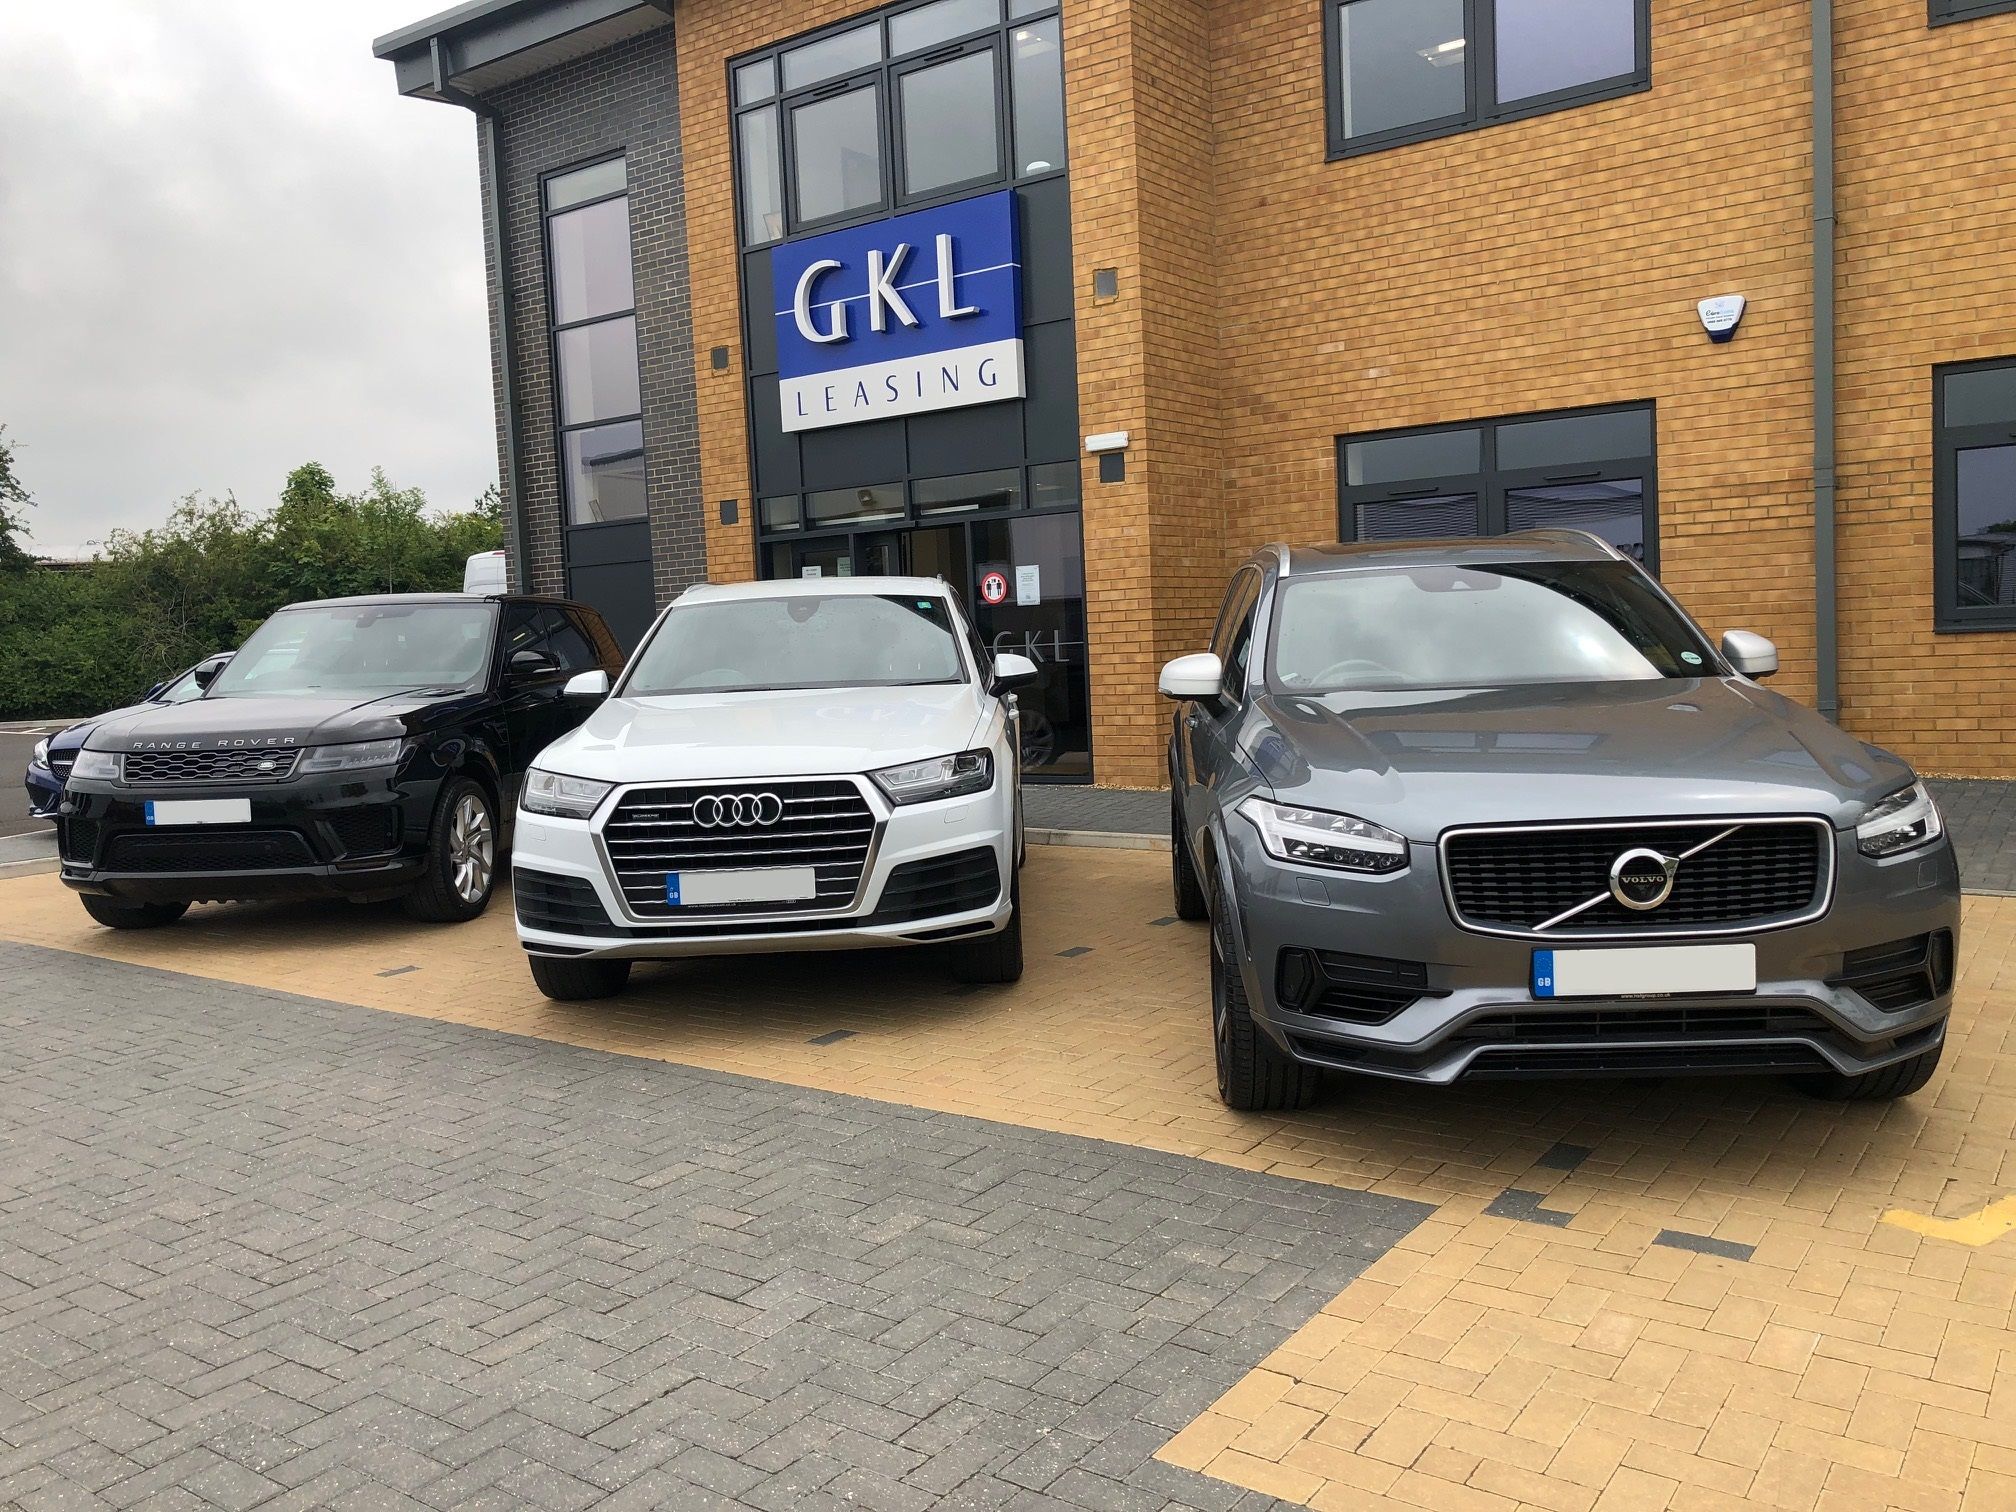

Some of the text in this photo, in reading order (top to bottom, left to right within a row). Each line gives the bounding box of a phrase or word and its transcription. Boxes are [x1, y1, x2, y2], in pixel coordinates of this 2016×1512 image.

[794, 233, 980, 343] GKL
[797, 358, 997, 416] LEASING
[993, 629, 1070, 663] GKL
[133, 737, 295, 749] RANGE ROVER
[669, 891, 679, 899] GB
[1537, 977, 1551, 987] GB
